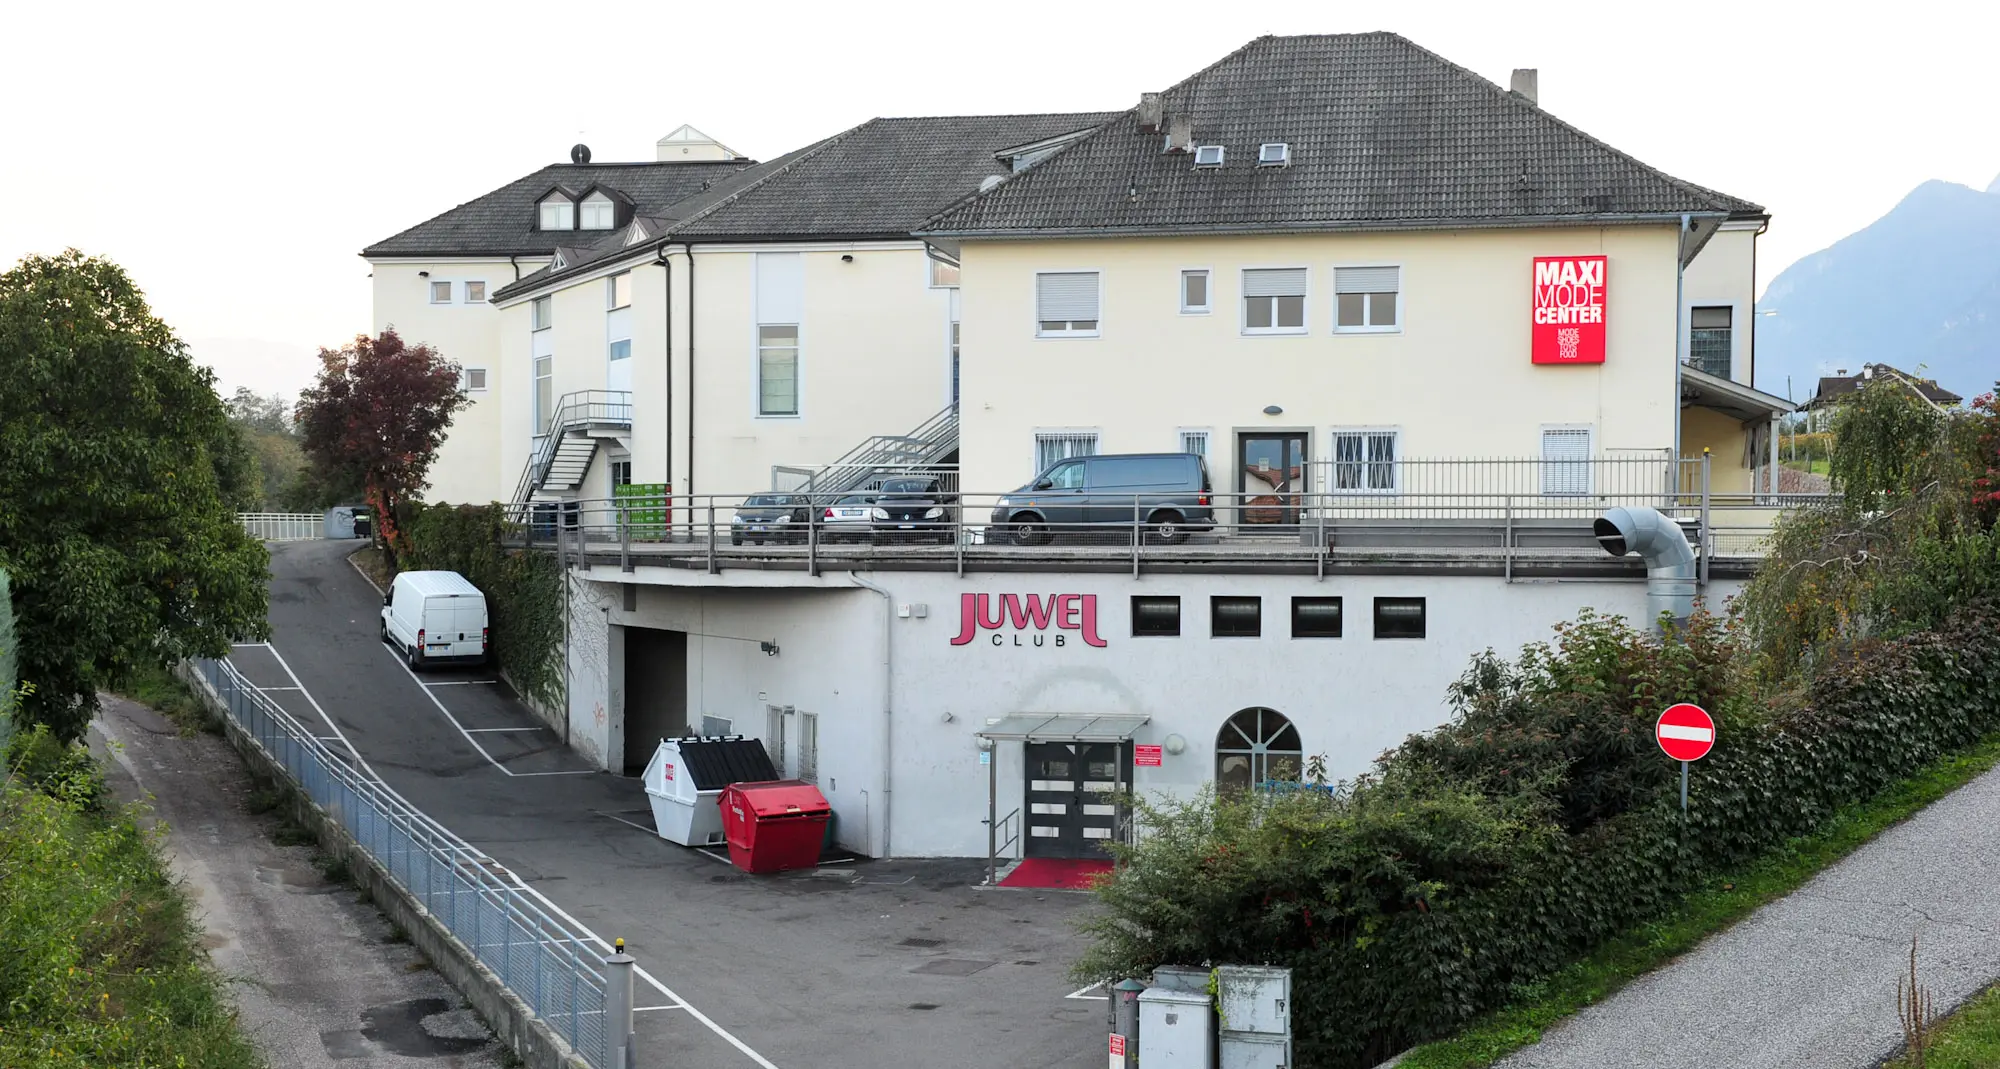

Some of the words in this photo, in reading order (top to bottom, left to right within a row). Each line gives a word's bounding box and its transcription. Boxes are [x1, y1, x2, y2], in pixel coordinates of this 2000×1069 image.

[1535, 261, 1604, 286] MAXI
[1535, 284, 1603, 308] MODE
[1534, 307, 1602, 324] CENTER
[1558, 328, 1579, 336] MODE
[1557, 335, 1580, 345] SHOES
[1560, 351, 1577, 359] FOOD
[950, 593, 1107, 647] JUWEL
[992, 634, 1065, 647] CLUB
